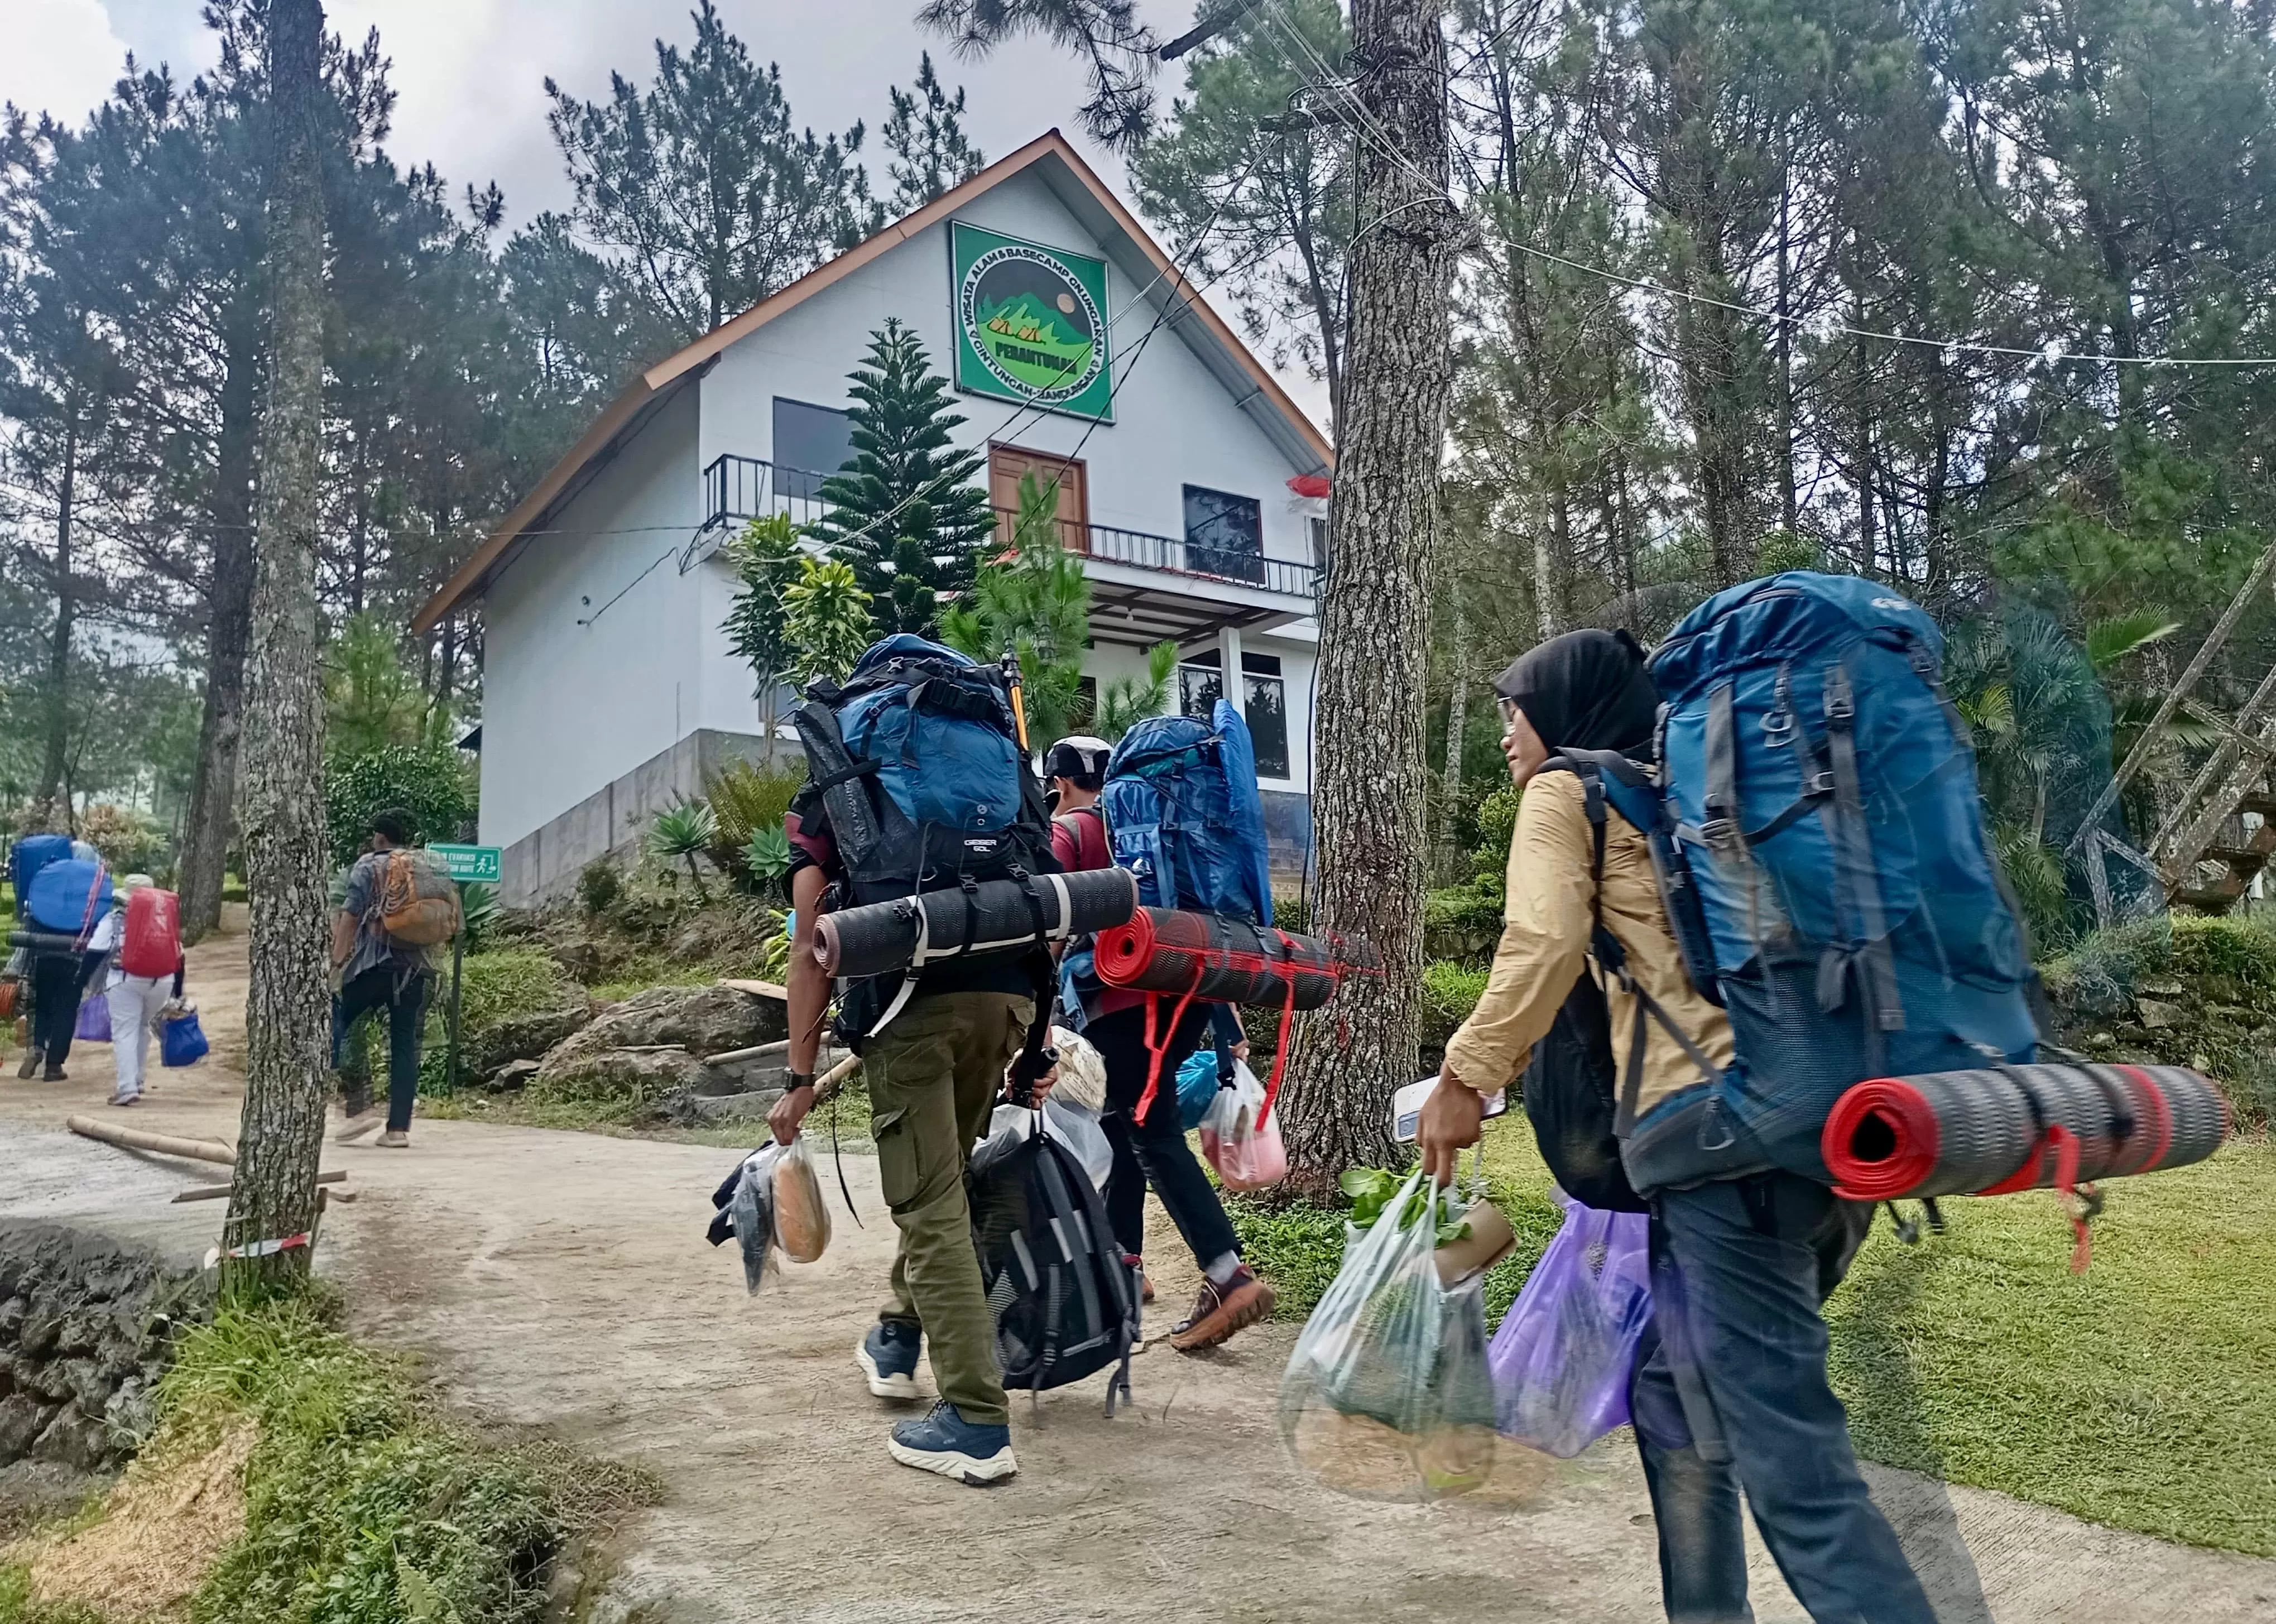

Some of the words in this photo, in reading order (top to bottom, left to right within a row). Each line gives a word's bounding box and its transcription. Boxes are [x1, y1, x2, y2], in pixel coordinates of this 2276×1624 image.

[963, 281, 976, 326] WISATA
[972, 252, 998, 280] ALAM
[1006, 248, 1069, 277] BASECAMP
